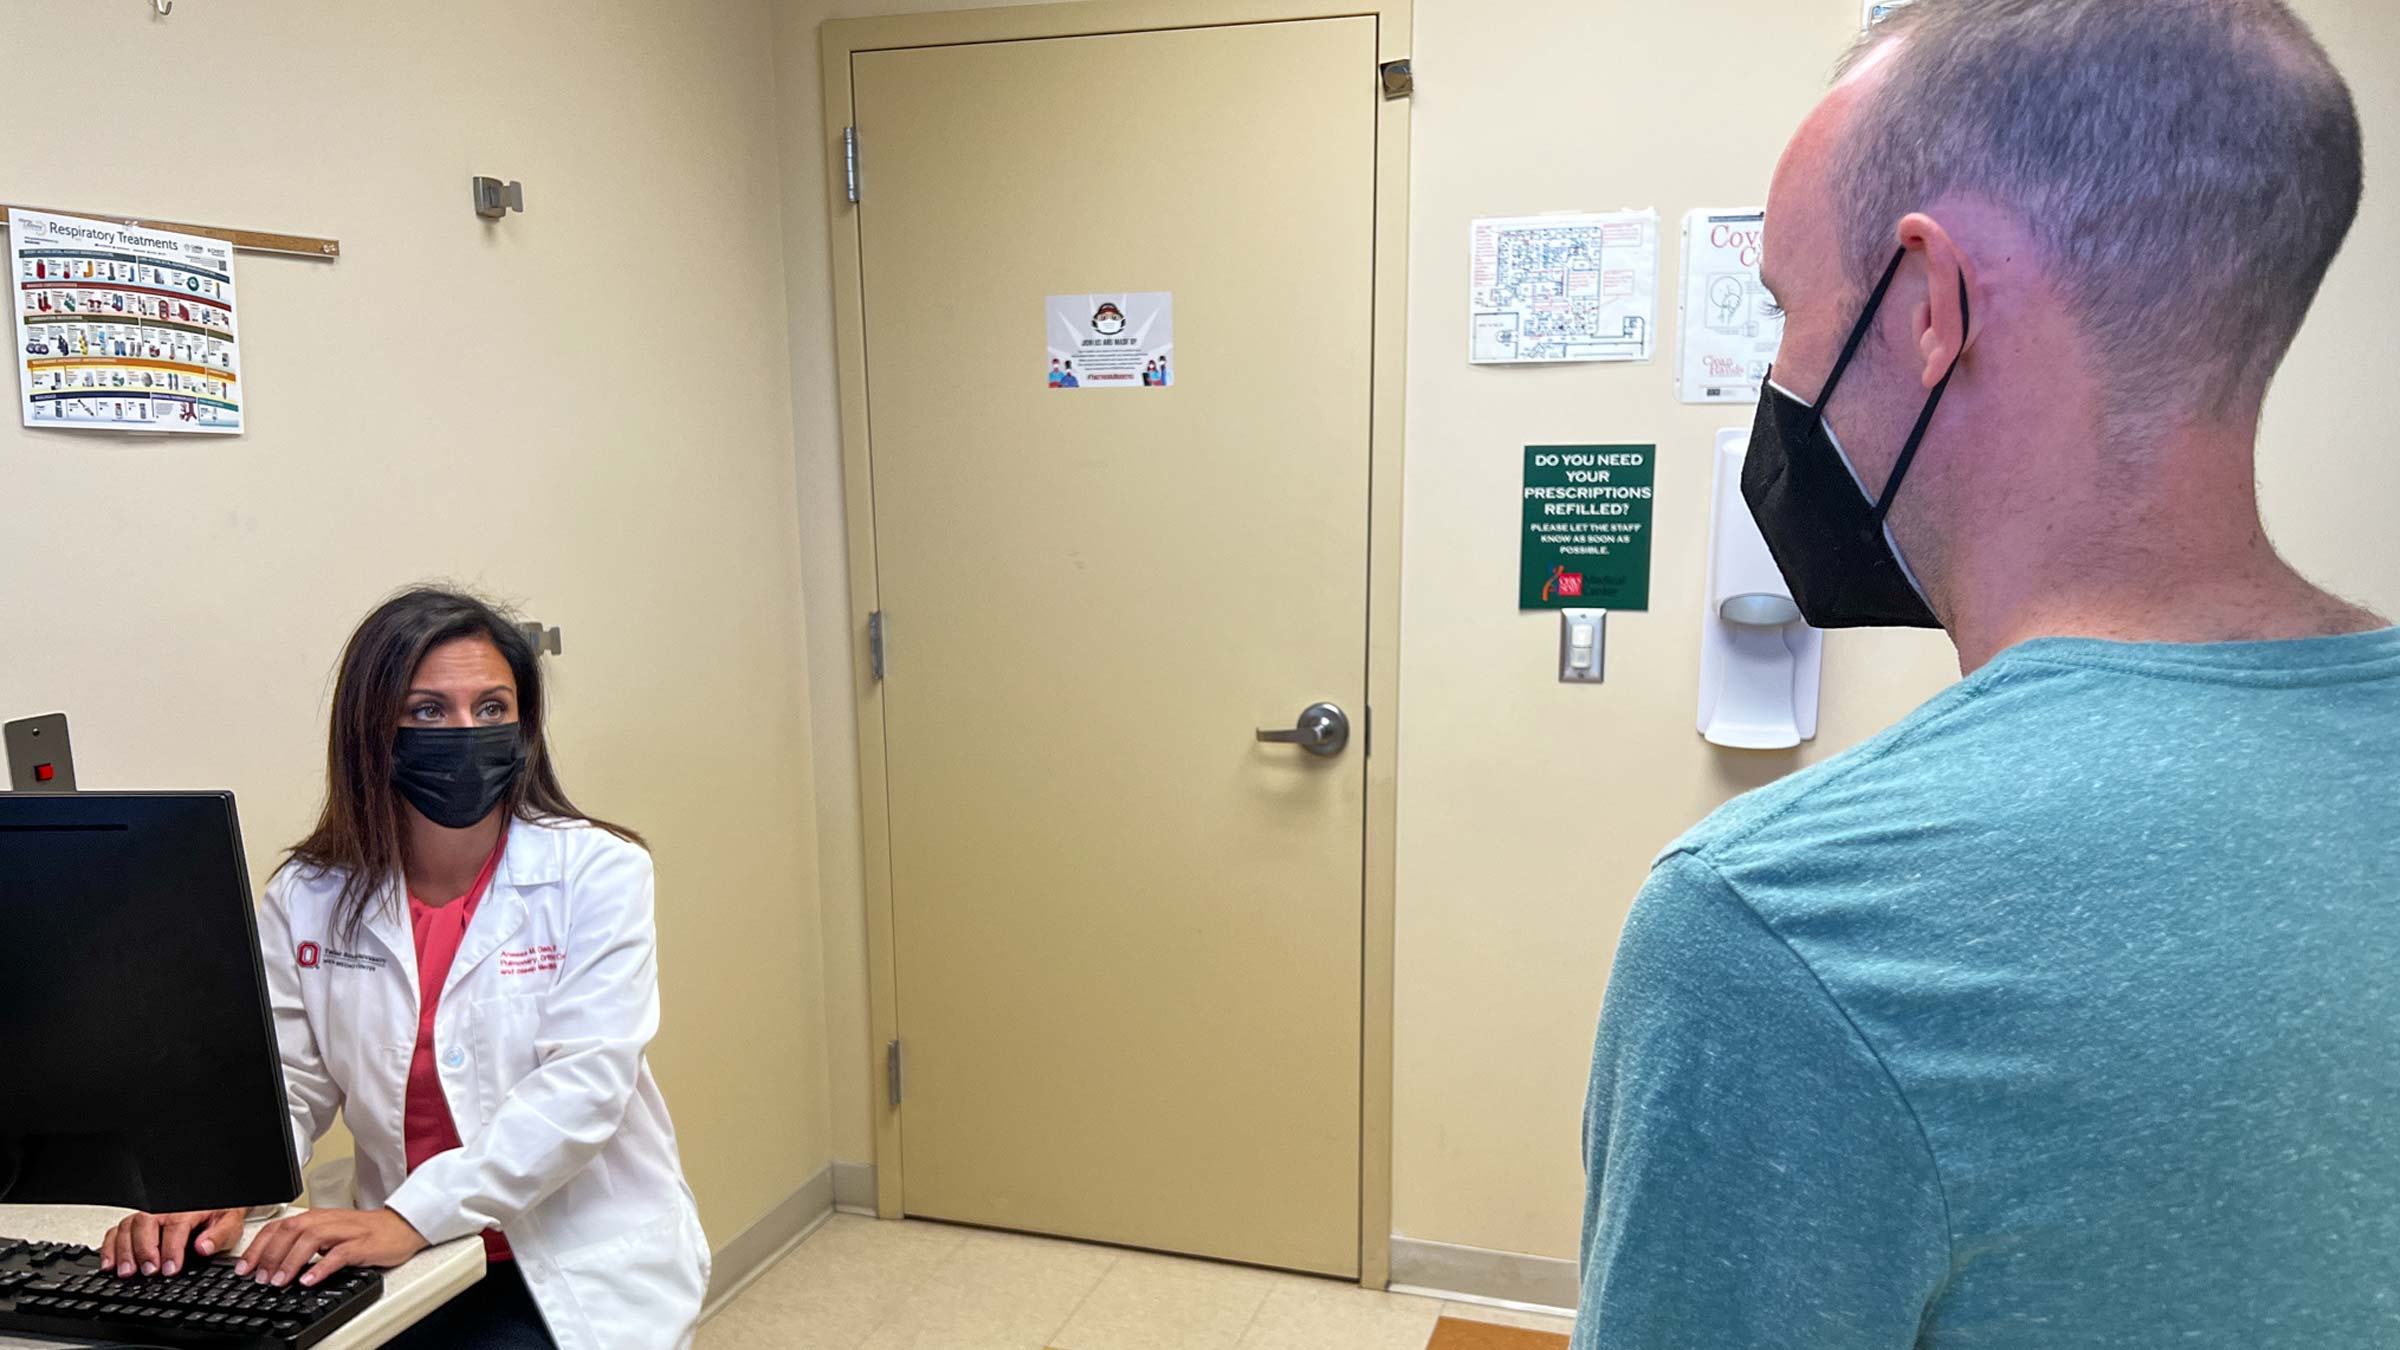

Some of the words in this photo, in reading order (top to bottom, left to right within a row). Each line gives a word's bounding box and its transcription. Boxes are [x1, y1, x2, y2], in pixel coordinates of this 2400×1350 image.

[49, 221, 115, 244] Respiratory
[117, 231, 178, 251] Treatments
[1535, 454, 1559, 466] DO
[1561, 454, 1594, 466] YOU
[1597, 454, 1643, 466] NEED
[1566, 470, 1610, 483] YOUR
[1524, 487, 1652, 499] PRESCRIPTIONS
[1544, 503, 1630, 515] REFILLED?
[1530, 523, 1568, 532] PLEASE
[1570, 523, 1590, 532] LET
[1590, 523, 1610, 532] THE
[1610, 523, 1641, 532] STAFF
[1541, 535, 1571, 543] KNOW
[1573, 535, 1586, 543] AS
[1587, 535, 1615, 543] SOON
[1617, 535, 1630, 543] AS
[1560, 546, 1609, 554] POSSIBLE.
